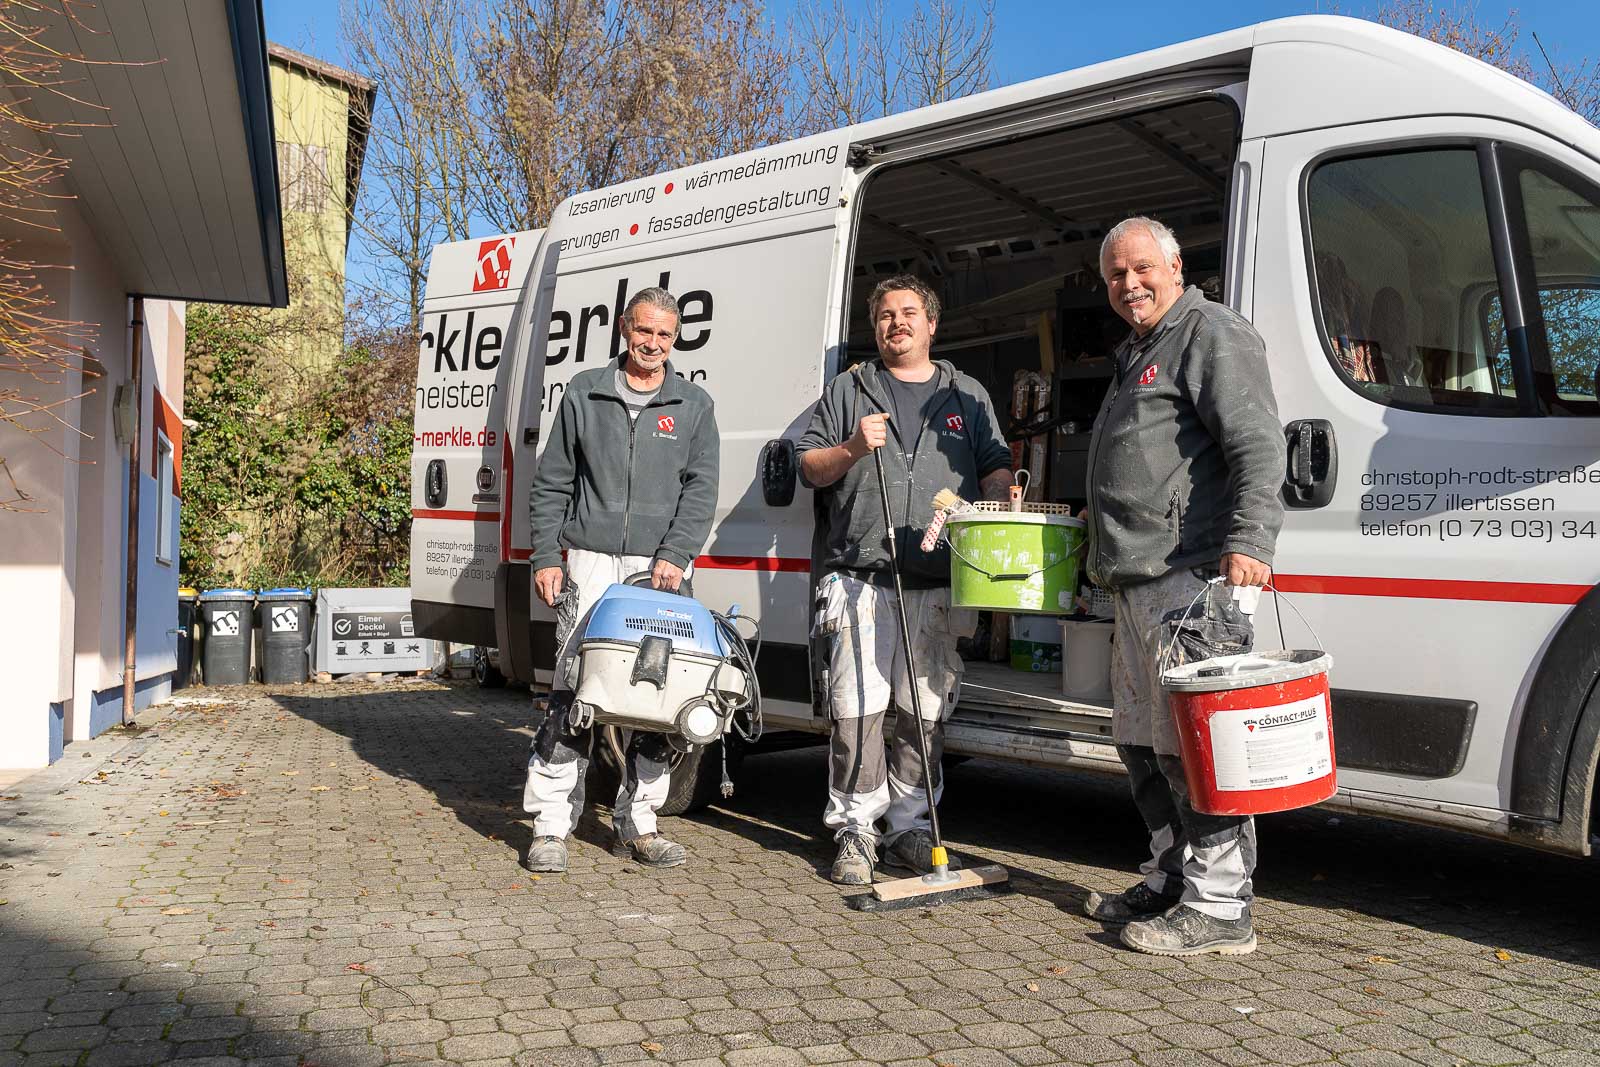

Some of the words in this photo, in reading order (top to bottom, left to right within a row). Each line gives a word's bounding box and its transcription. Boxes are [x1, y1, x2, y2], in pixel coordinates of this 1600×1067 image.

[685, 144, 839, 192] wärmedämmung
[560, 227, 620, 252] erungen
[647, 185, 831, 235] fassadengestaltung
[545, 271, 714, 366] ere
[413, 426, 496, 447] -merkle.de
[1361, 465, 1600, 489] christoph-rodt-straße
[1361, 494, 1437, 511] 89257
[1445, 494, 1555, 511] illertissen
[1360, 520, 1431, 537] telefon
[1439, 520, 1462, 542] (0
[1470, 520, 1502, 538] 73
[1511, 520, 1552, 543] 03)
[1562, 520, 1597, 539] 34
[426, 551, 451, 563] 89257
